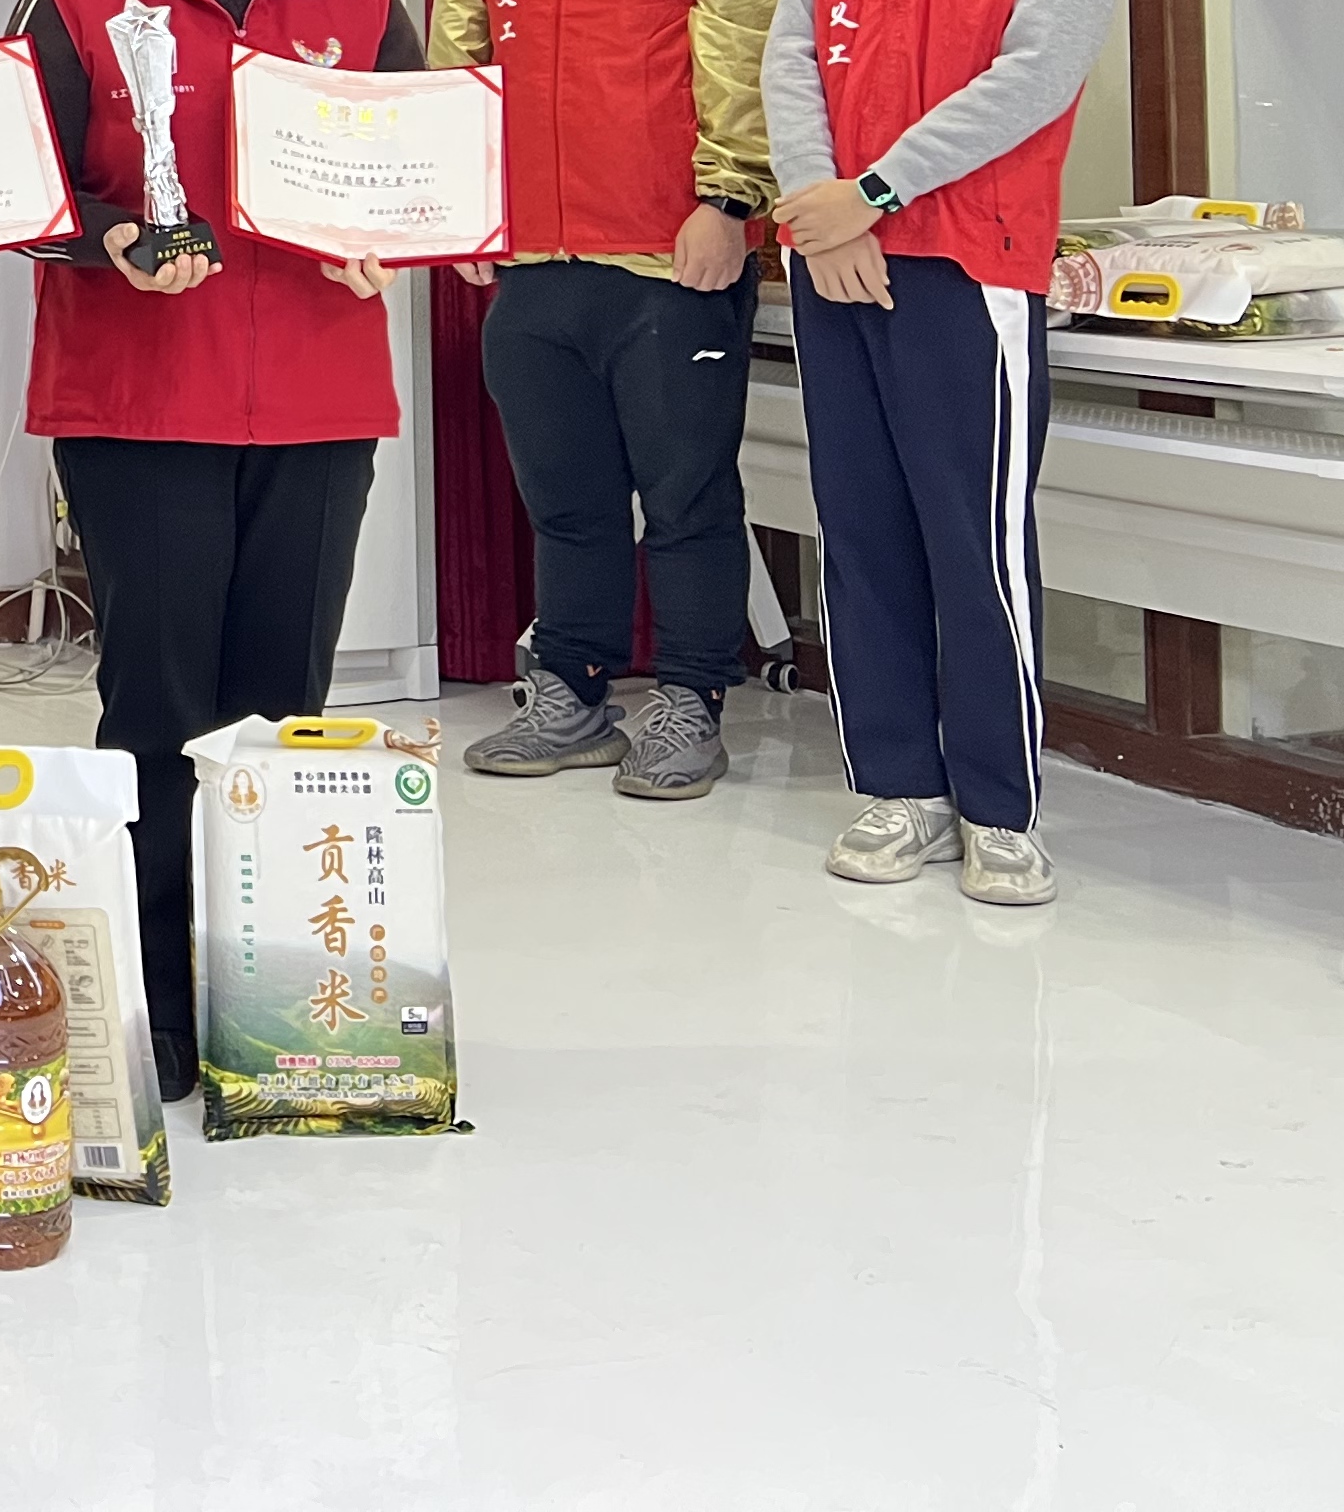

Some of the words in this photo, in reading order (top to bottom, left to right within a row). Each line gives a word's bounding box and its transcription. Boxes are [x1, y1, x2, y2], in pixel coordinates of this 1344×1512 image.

[303, 824, 366, 1031] 贡香米
[365, 825, 385, 906] 隆林高山
